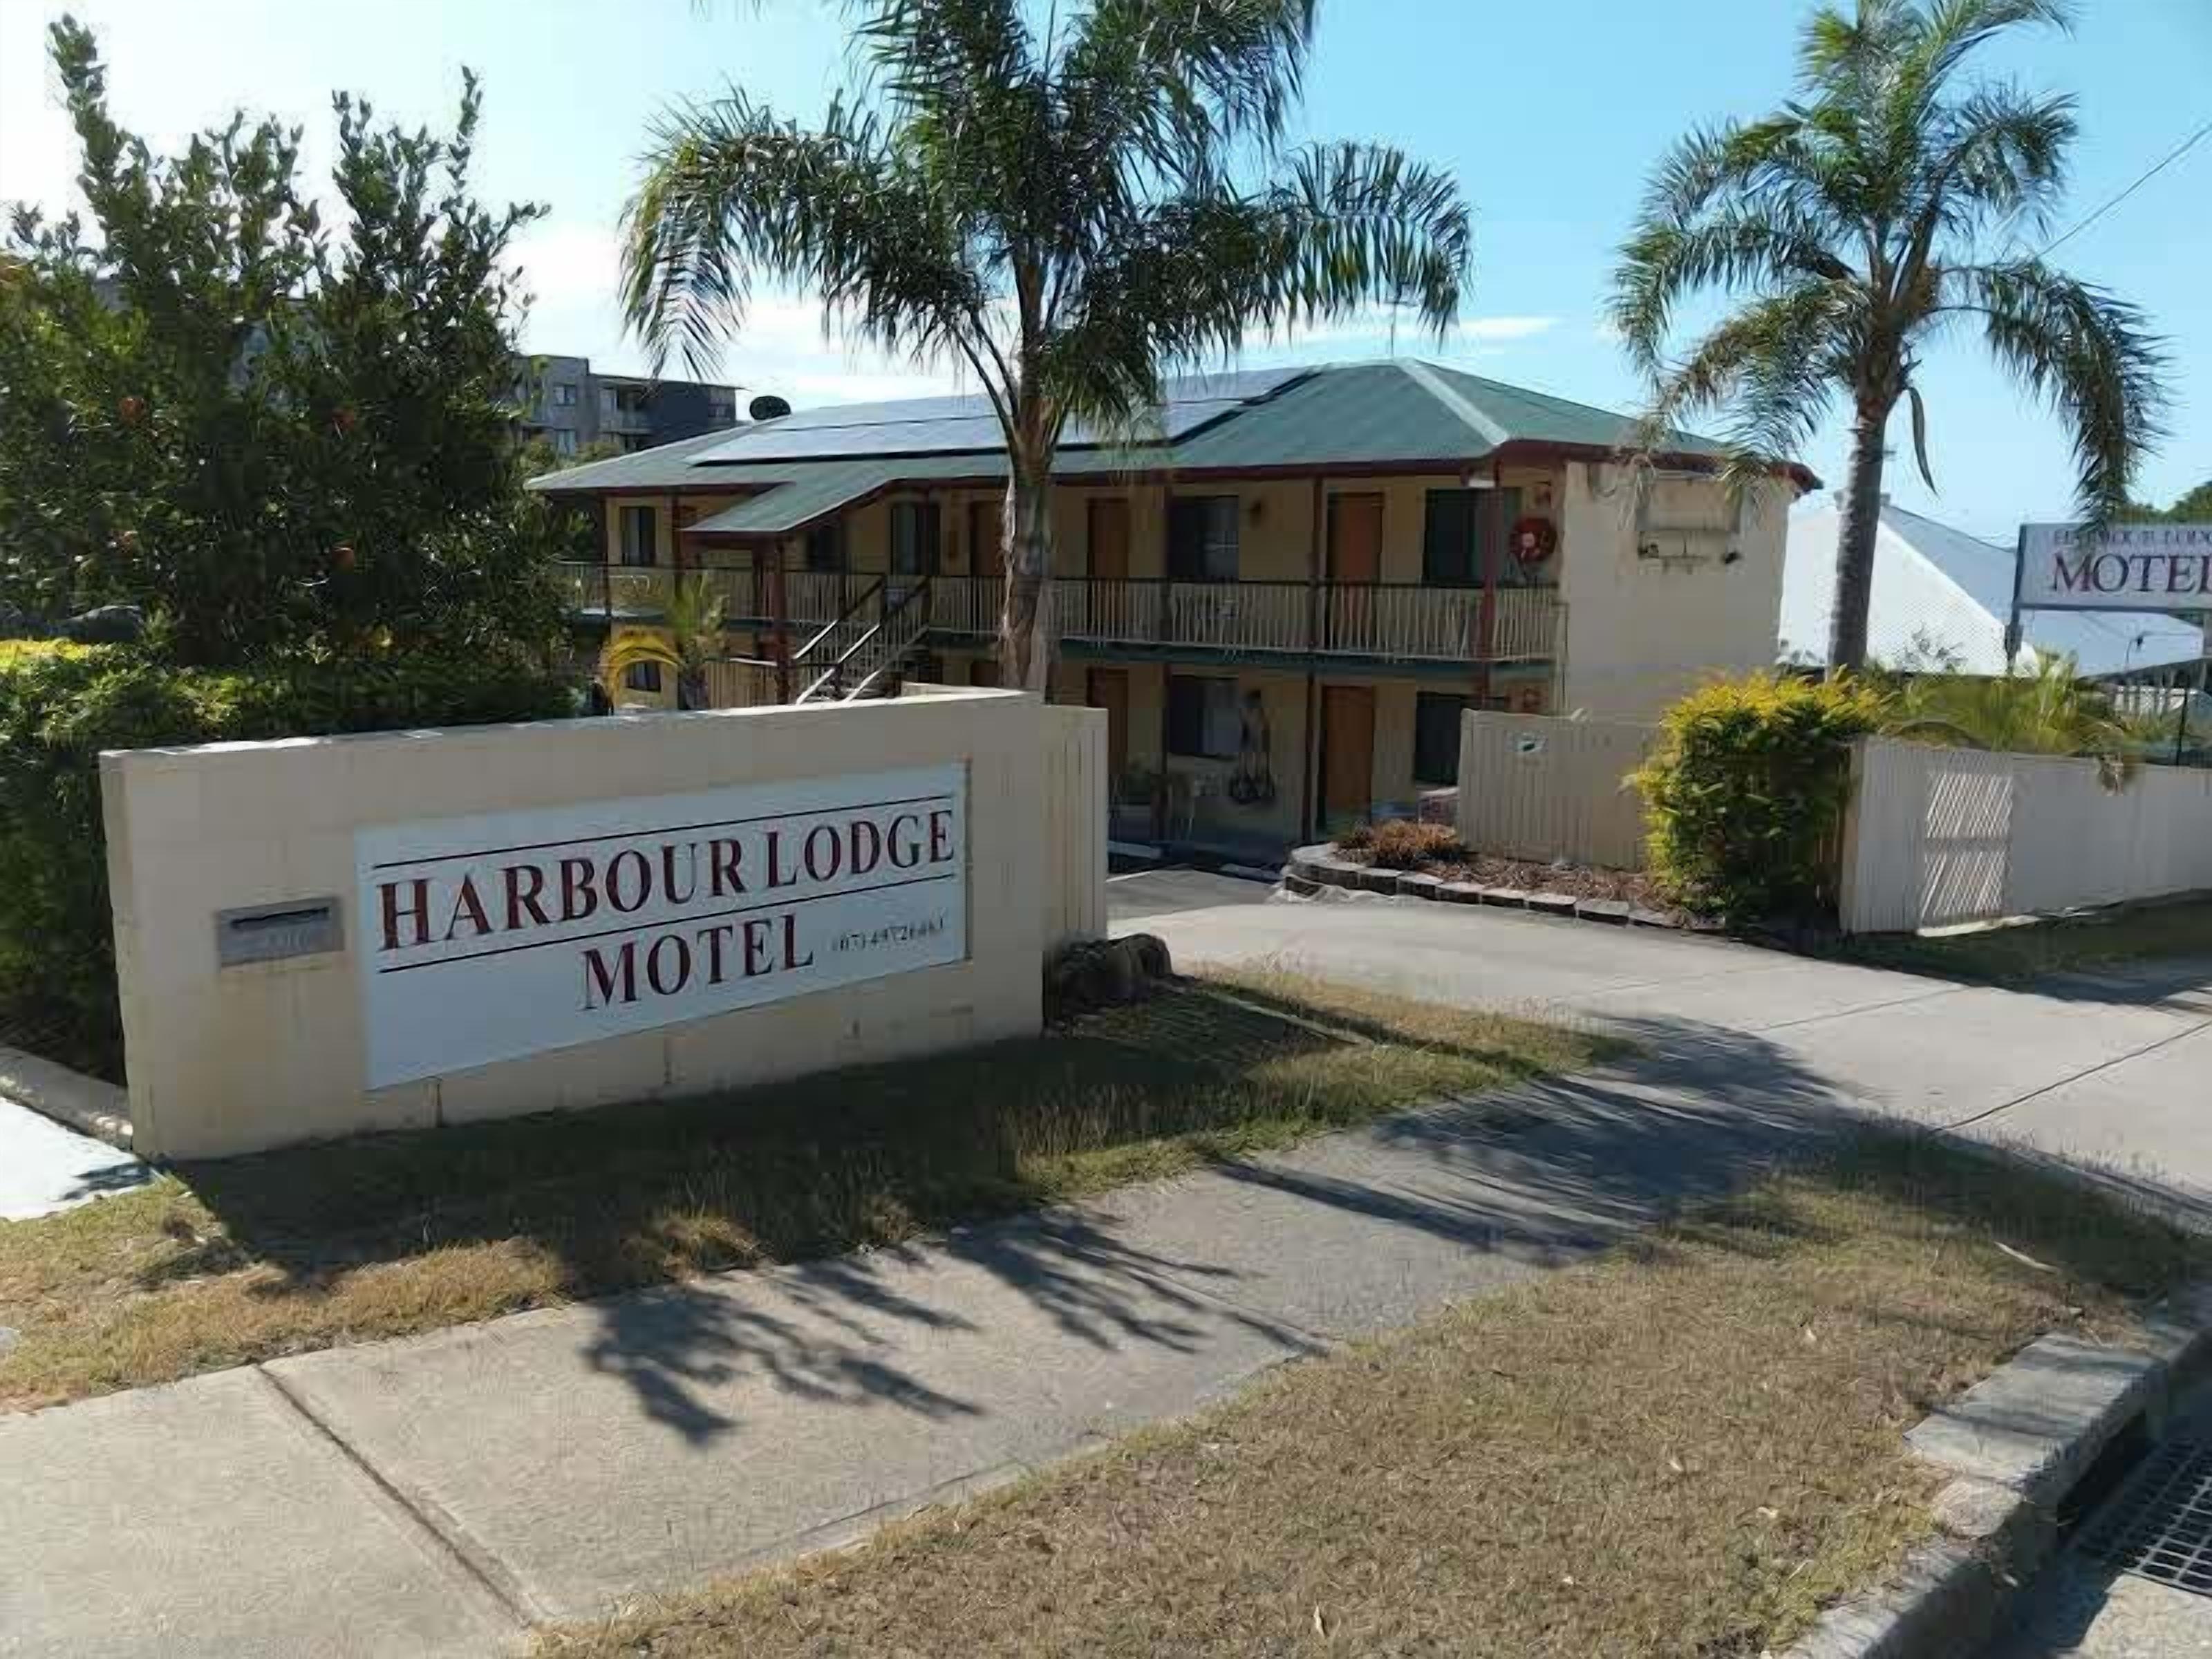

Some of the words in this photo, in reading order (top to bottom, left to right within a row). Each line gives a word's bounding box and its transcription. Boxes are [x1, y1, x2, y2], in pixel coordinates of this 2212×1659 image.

[376, 838, 747, 952] HARBOUR
[765, 809, 955, 888] LODGE
[581, 914, 814, 1011] MOTEL
